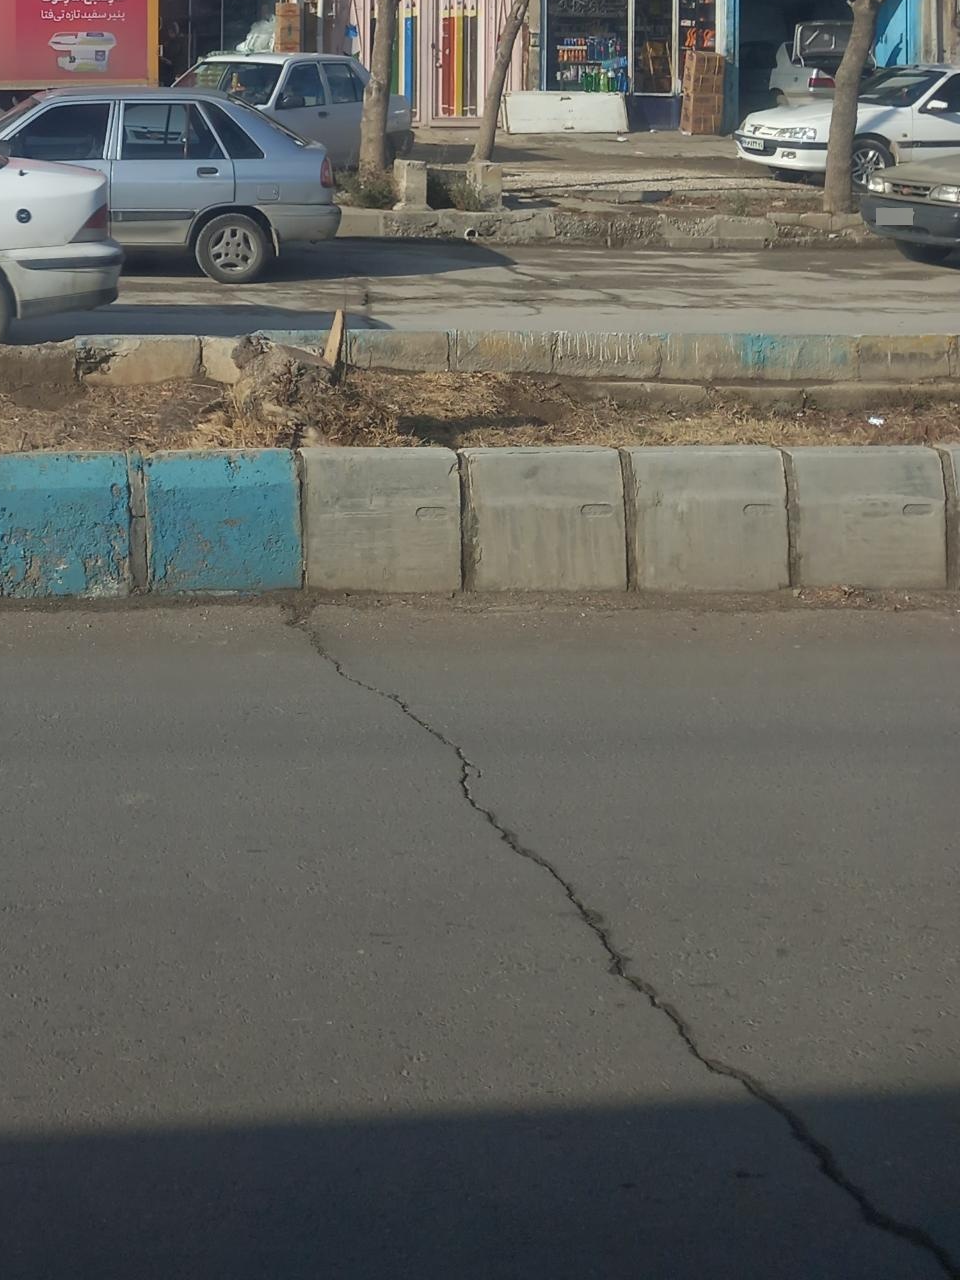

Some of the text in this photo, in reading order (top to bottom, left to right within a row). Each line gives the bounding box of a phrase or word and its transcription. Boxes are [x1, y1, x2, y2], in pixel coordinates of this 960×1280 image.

[65, 9, 81, 21] تازه
[81, 9, 107, 21] سفید
[107, 10, 125, 21] پنیر
